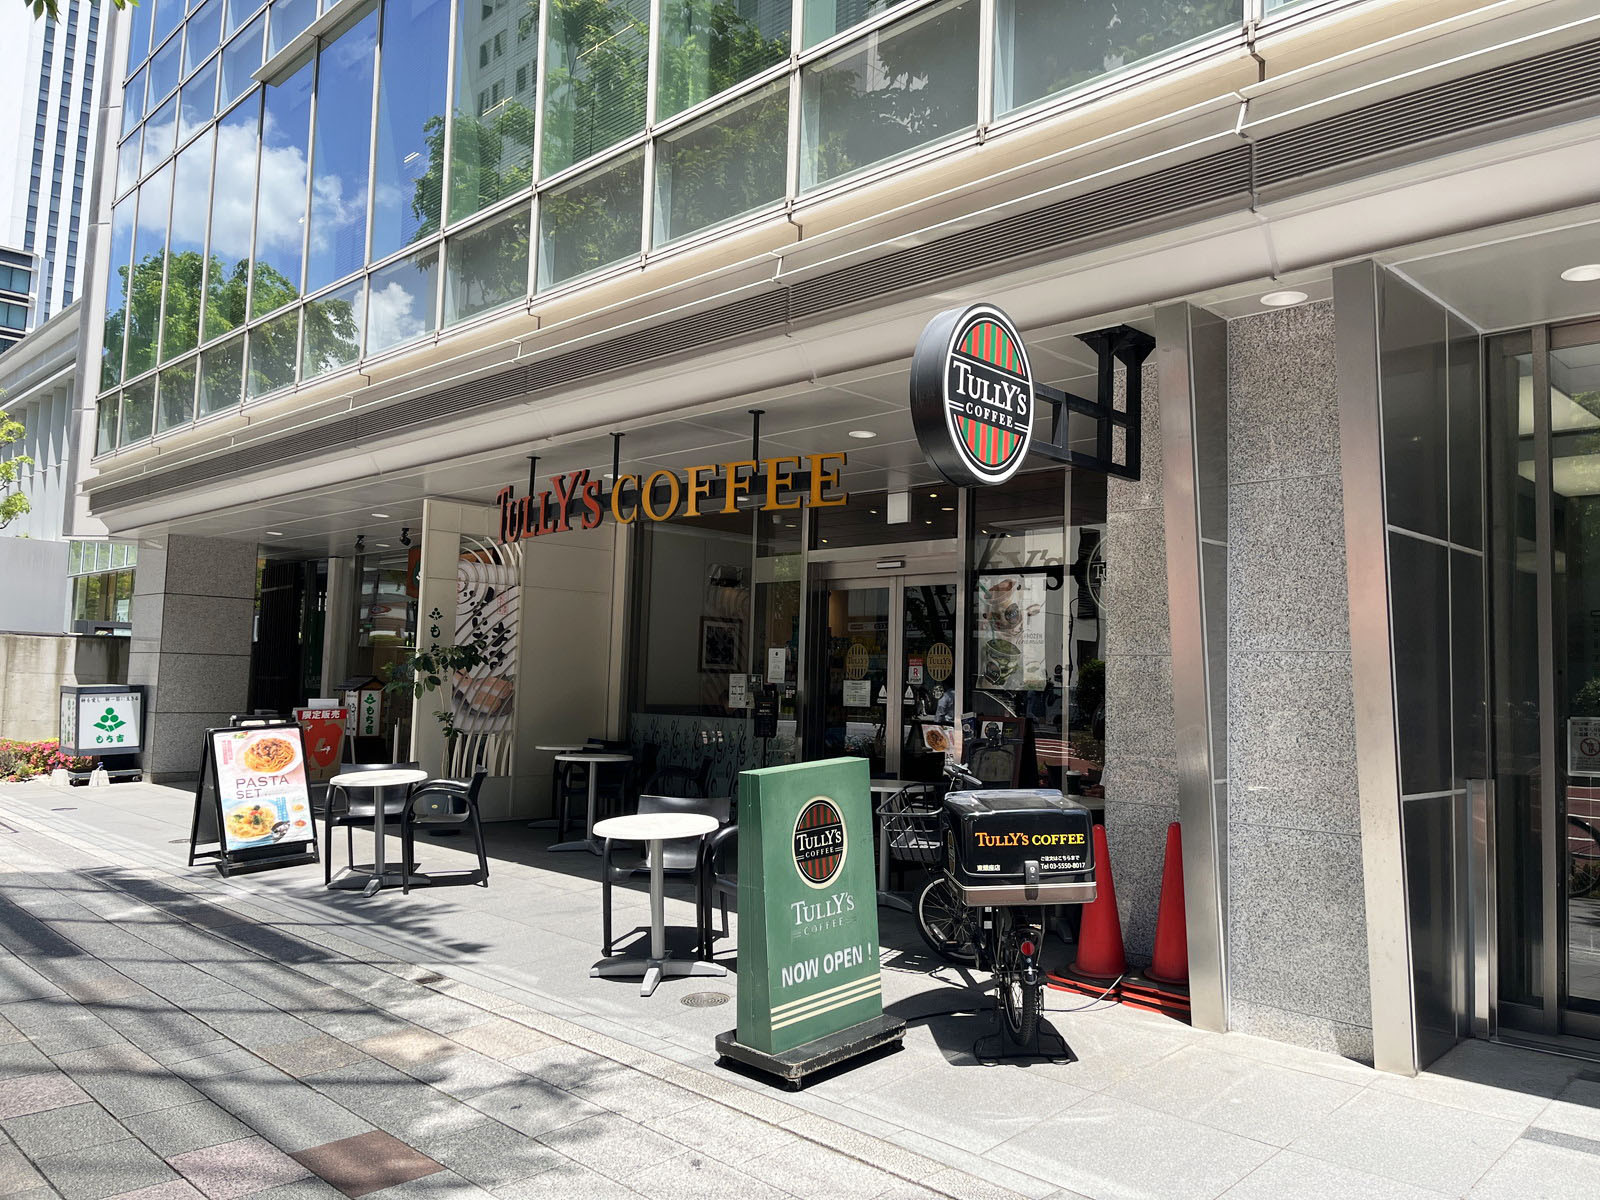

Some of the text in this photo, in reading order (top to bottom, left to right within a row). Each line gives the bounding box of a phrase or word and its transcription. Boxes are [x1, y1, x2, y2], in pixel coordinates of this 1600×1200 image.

[953, 360, 1026, 415] TULLY'S
[966, 402, 1013, 428] COFFEE
[496, 452, 849, 545] TULLY'S COFFEE
[301, 710, 340, 720] 限定販売
[365, 705, 375, 735] もち吉
[96, 733, 125, 744] もち吉
[236, 775, 290, 789] PASTA
[236, 789, 262, 799] SET
[796, 828, 842, 851] TULLY'S
[975, 832, 1085, 846] TULLY'S COFFEE
[805, 847, 834, 859] COFFEE
[791, 892, 855, 926] TULLY'S
[803, 917, 844, 936] COFFEE
[781, 957, 819, 988] NOW
[823, 944, 863, 974] OPEN
